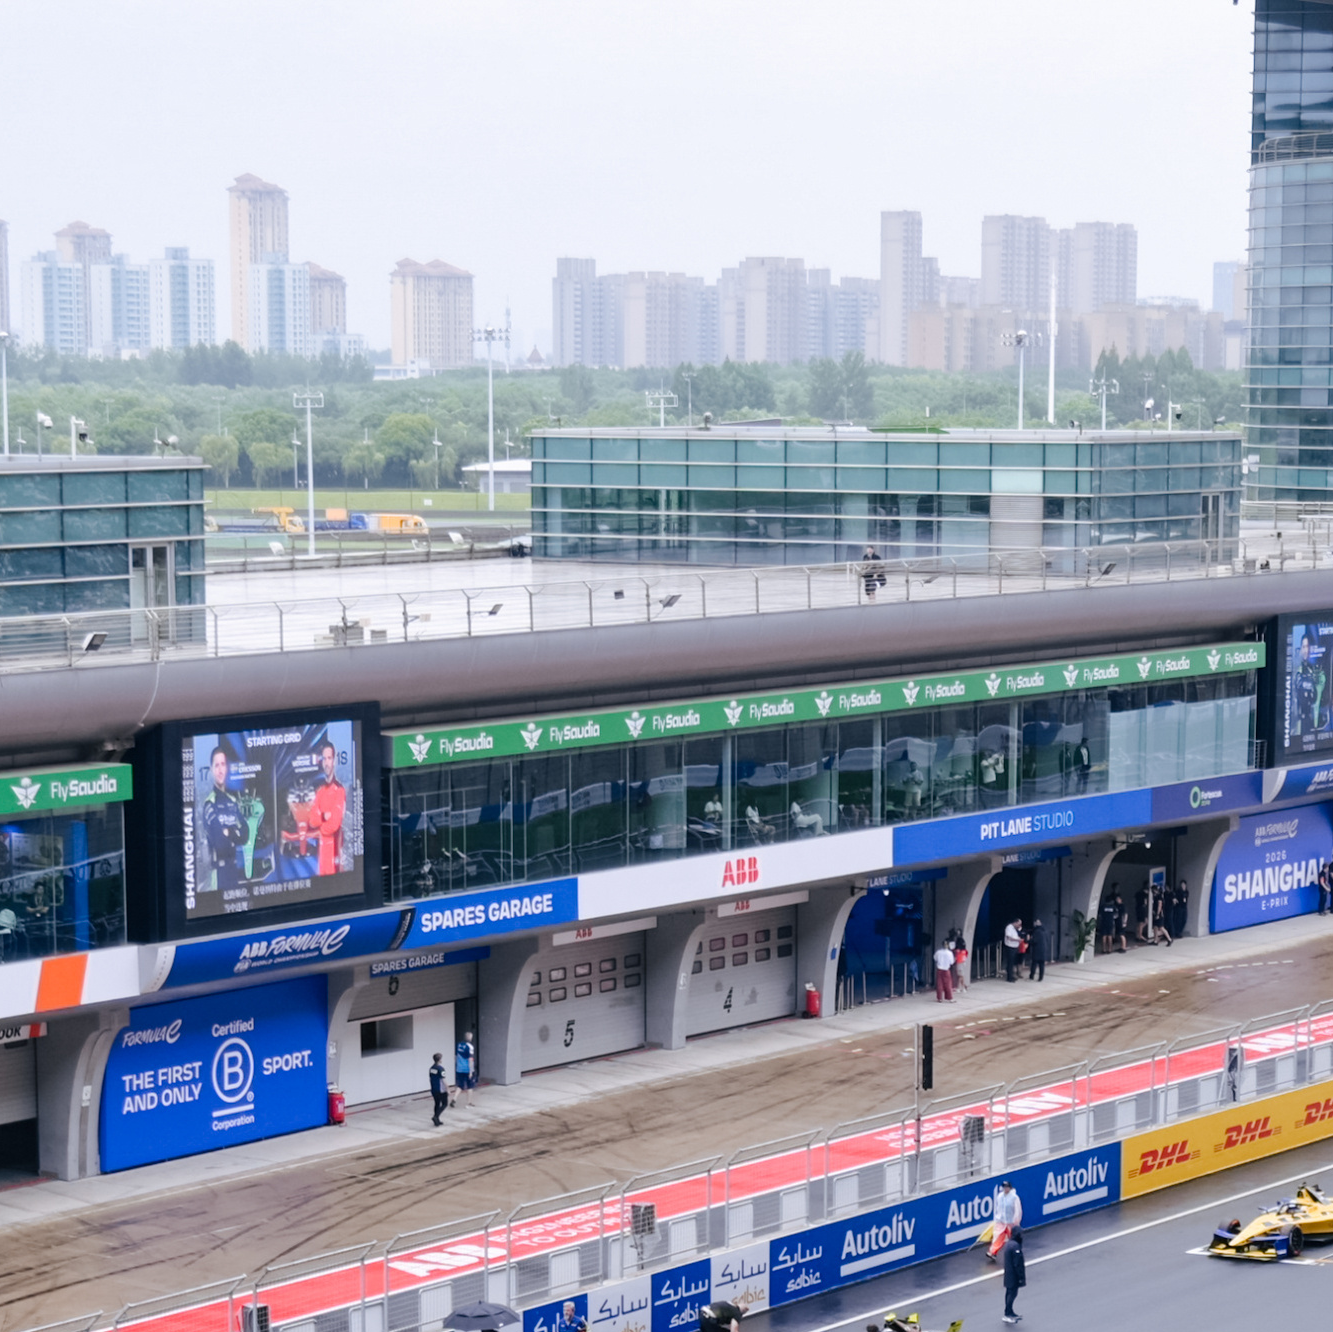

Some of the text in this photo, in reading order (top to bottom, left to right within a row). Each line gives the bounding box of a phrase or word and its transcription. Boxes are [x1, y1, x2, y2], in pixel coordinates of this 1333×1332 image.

[247, 732, 301, 748] STARTING GRID
[980, 811, 1074, 841] PIT LANE STUDIO
[184, 807, 195, 910] SHANGHAI
[1265, 850, 1287, 863] 2026
[721, 857, 759, 888] ABB
[1224, 857, 1325, 904] SHANGHAI
[421, 894, 553, 932] SPARES GARAGE
[1262, 896, 1289, 910] E-PRIX
[239, 941, 267, 959] ABB
[372, 953, 445, 975] SPARES GARAGE
[723, 986, 733, 1013] 4
[212, 1017, 254, 1038] Certified
[563, 1019, 575, 1047] 5
[122, 1061, 203, 1093] THE FIRST
[223, 1051, 243, 1091] B
[263, 1050, 314, 1076] SPORT.
[122, 1082, 203, 1115] AND ONLY
[212, 1115, 255, 1132] Corporation
[1224, 1116, 1274, 1149] DHL
[1138, 1139, 1192, 1175] DHL
[1044, 1156, 1109, 1201] Autoliv
[841, 1213, 916, 1260] Autoliv
[772, 1243, 822, 1271] سابك
[715, 1259, 766, 1288] سابك
[786, 1267, 822, 1293] sabic
[654, 1275, 708, 1306] سابك
[593, 1294, 648, 1324] سابك
[669, 1304, 701, 1328] sabi
